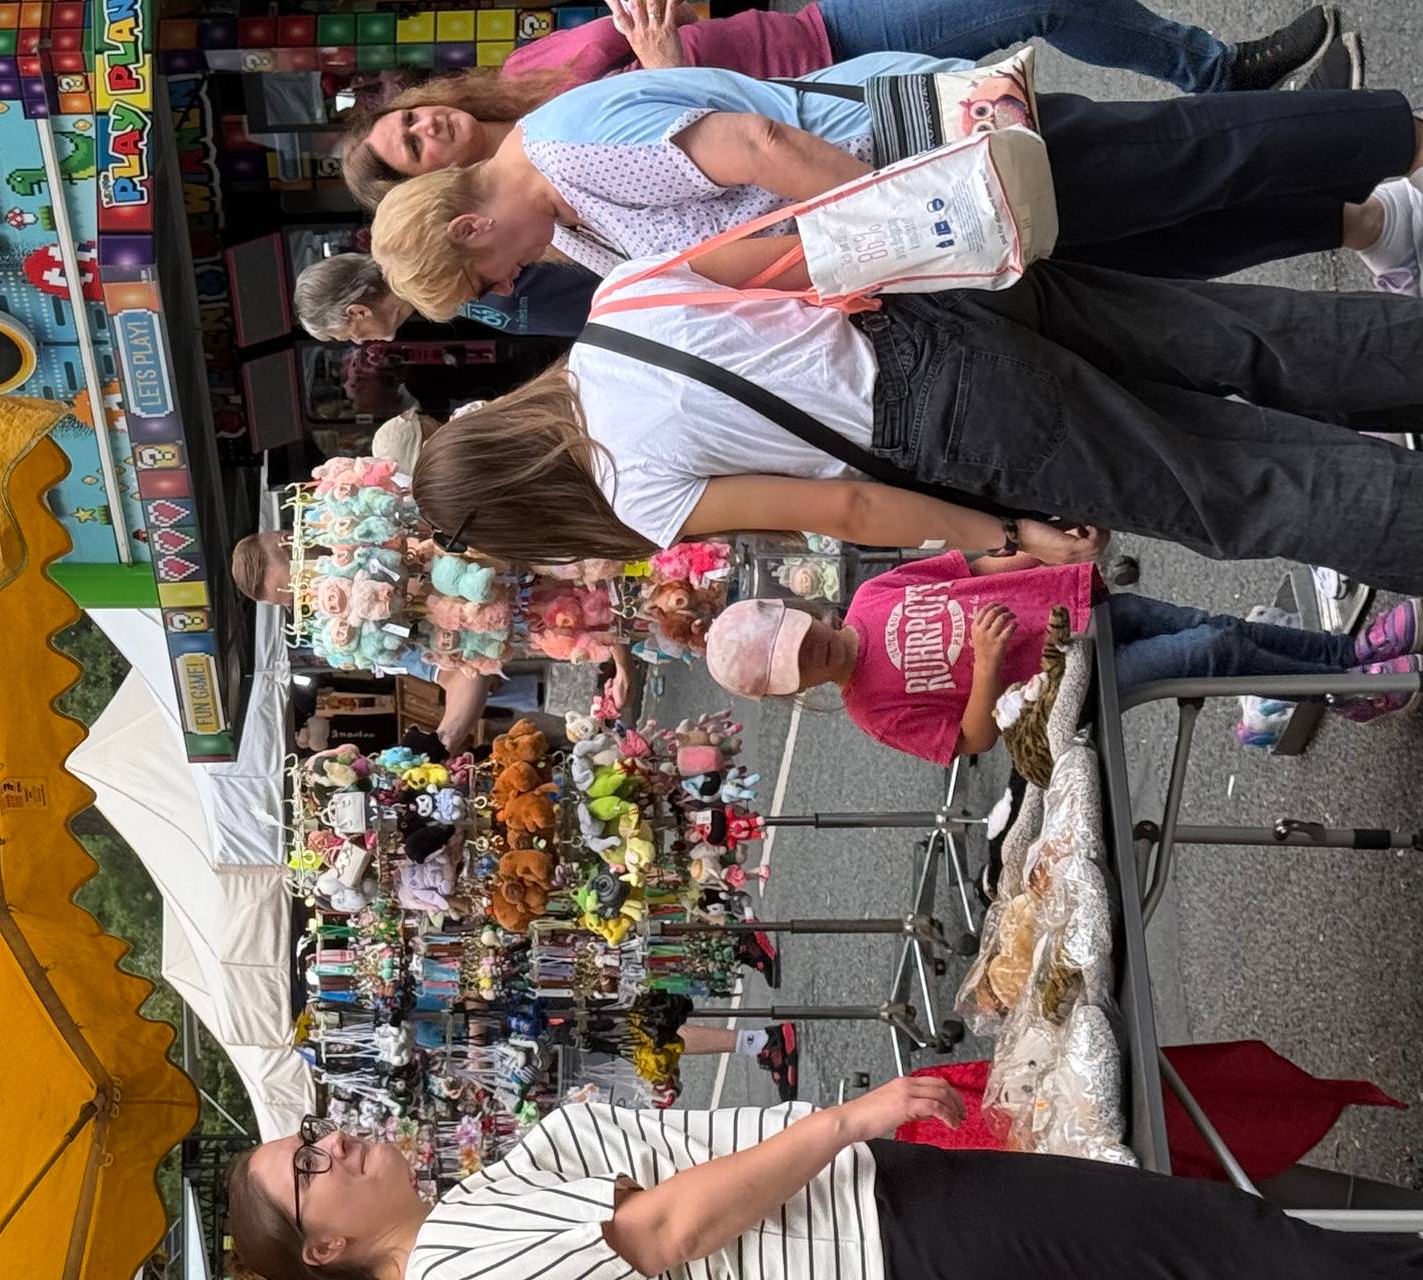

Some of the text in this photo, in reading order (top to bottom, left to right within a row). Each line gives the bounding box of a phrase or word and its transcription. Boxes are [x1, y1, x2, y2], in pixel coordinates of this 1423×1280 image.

[110, 103, 145, 204] PLAY
[127, 321, 162, 406] LETS PLAY!
[903, 581, 957, 694] RUHRPOTT
[953, 610, 963, 646] PERLE
[185, 663, 214, 726] FUN GAME!
